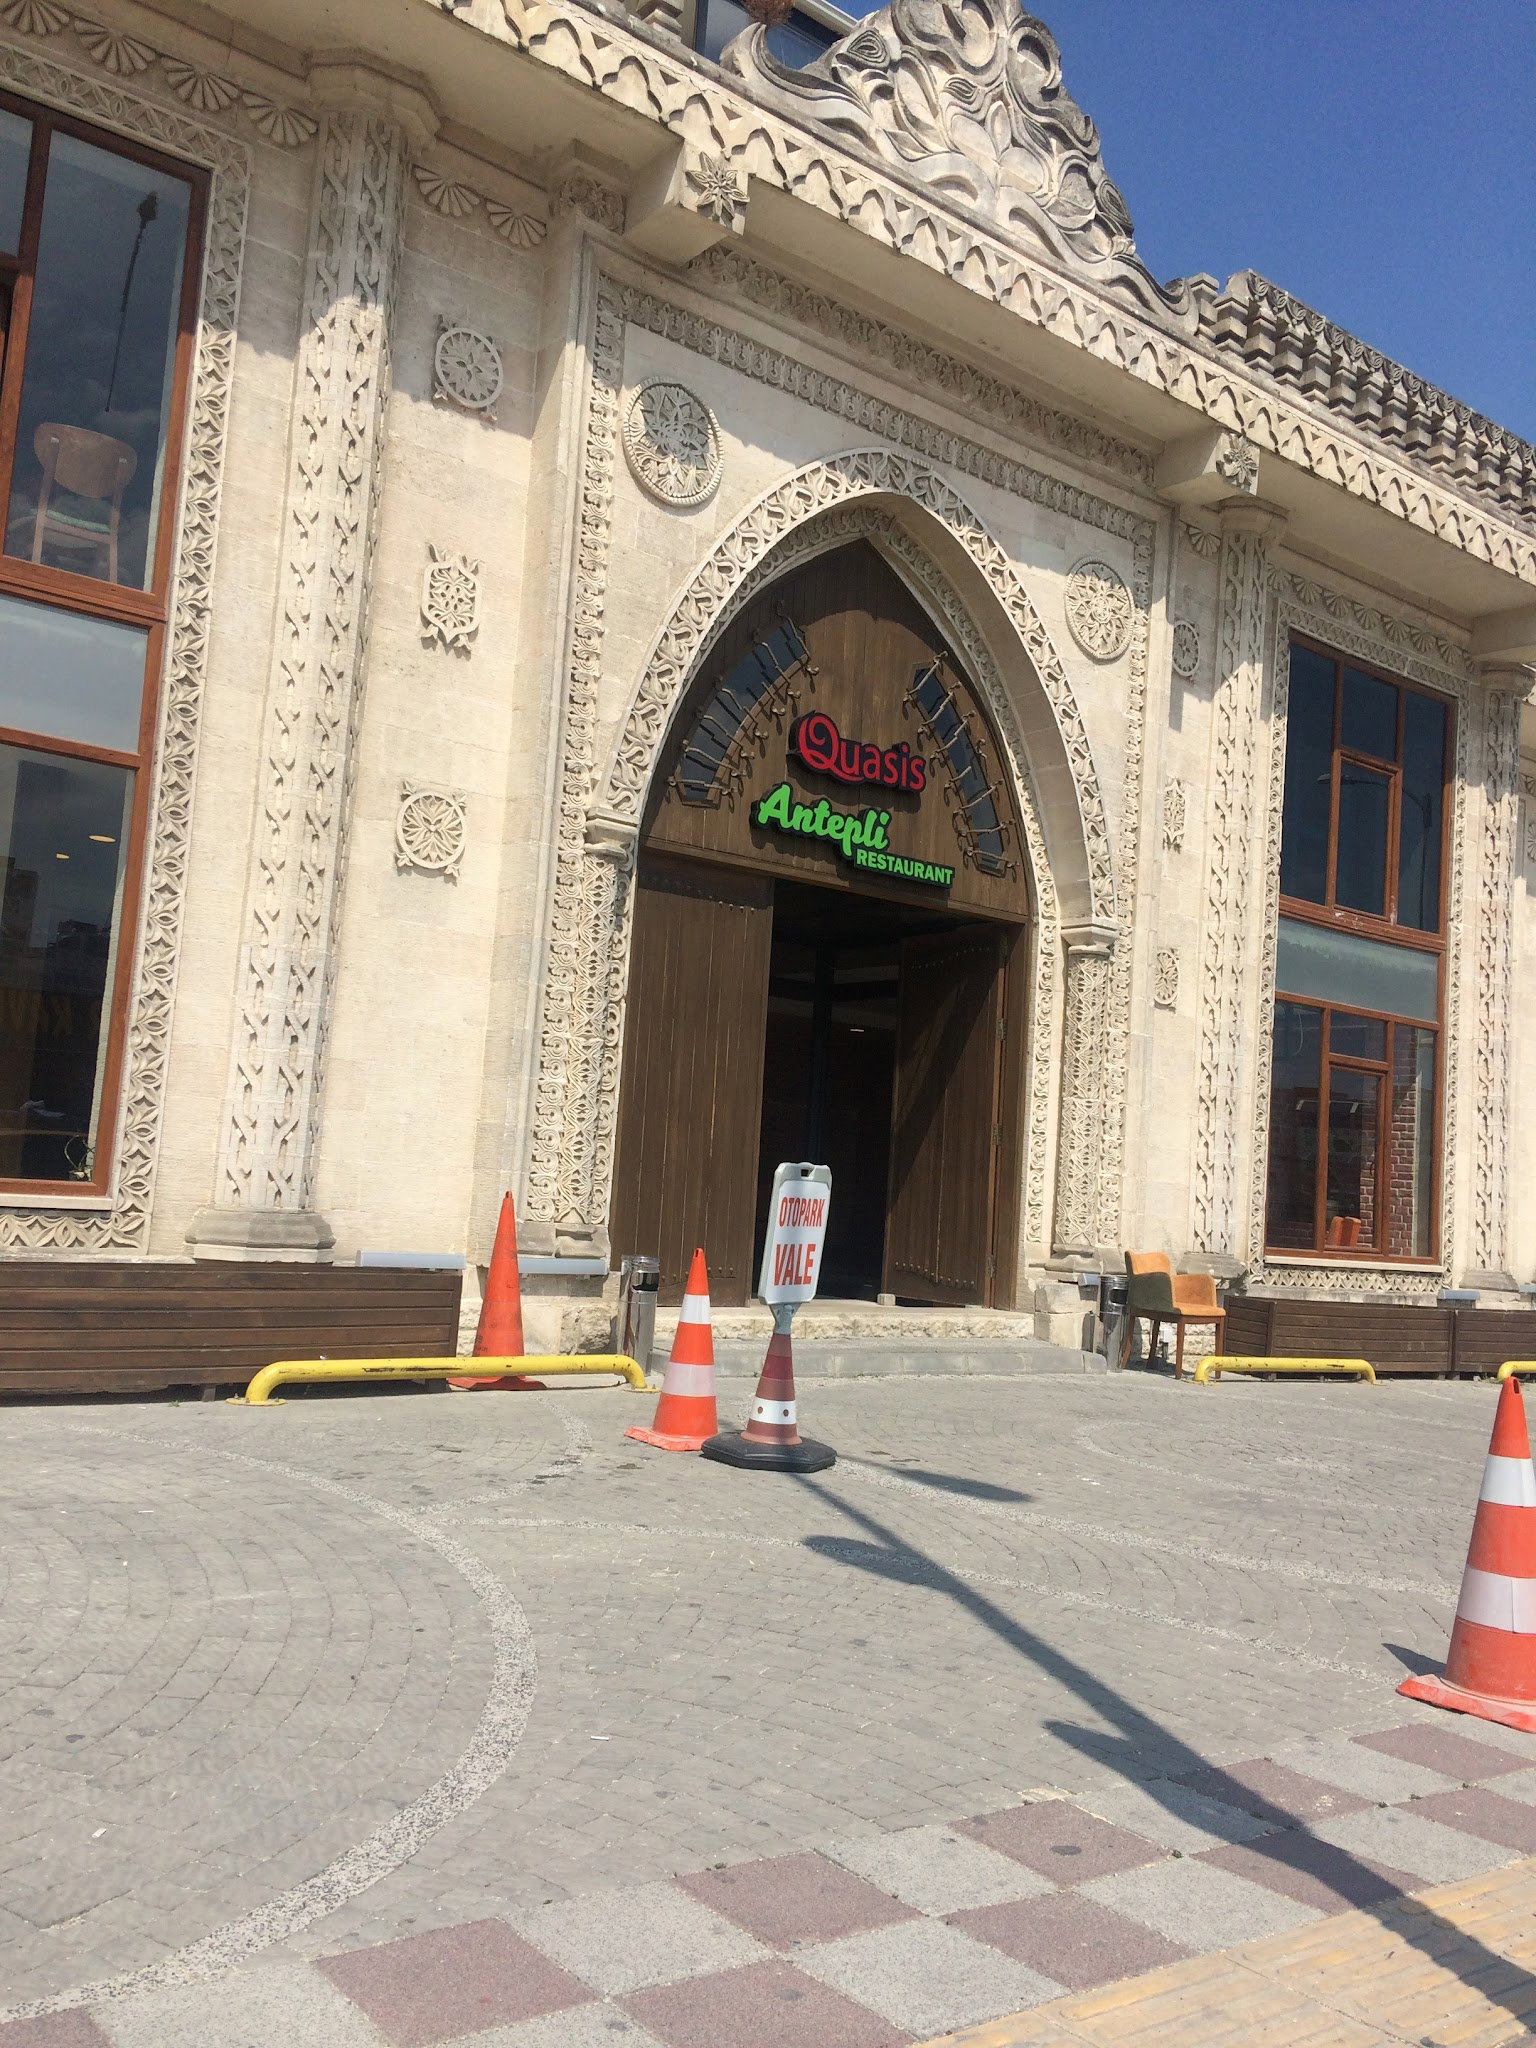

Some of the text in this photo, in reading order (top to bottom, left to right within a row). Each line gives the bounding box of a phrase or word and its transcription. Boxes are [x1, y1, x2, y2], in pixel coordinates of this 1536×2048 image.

[798, 715, 926, 790] Quasis
[758, 784, 891, 856] Antepli
[856, 849, 953, 885] RESTAURANT
[778, 1197, 826, 1227] OTOPARK
[774, 1243, 816, 1286] VALE
